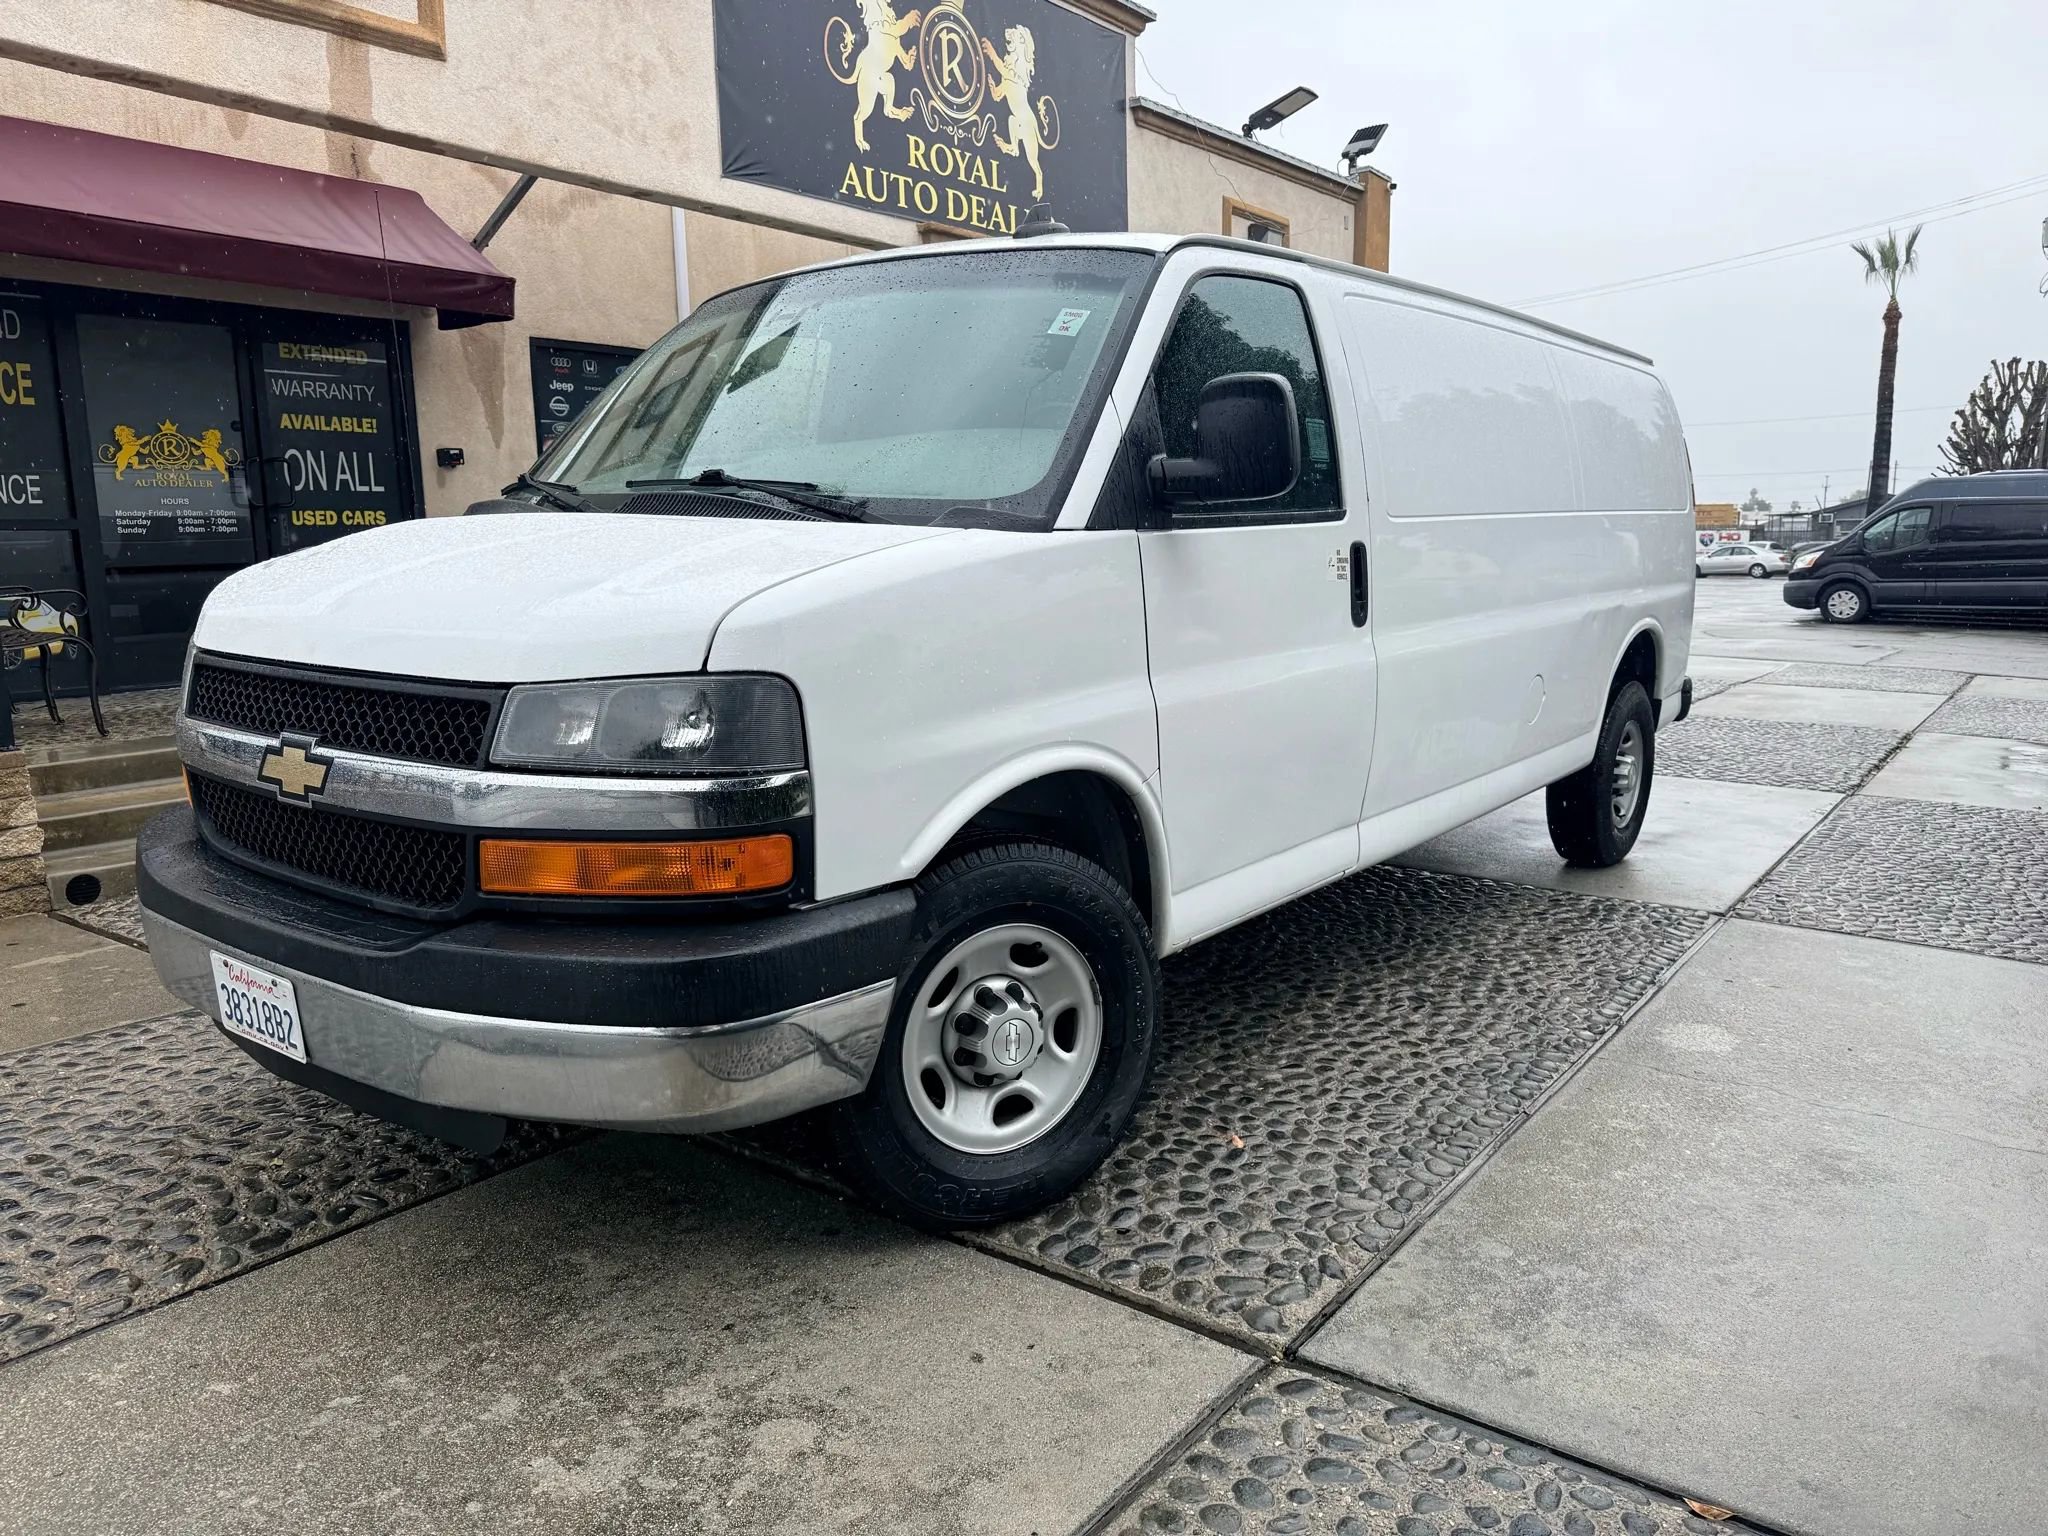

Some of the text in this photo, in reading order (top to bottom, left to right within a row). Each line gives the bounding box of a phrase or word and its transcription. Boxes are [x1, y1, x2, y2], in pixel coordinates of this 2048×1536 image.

[939, 28, 968, 93] R
[906, 134, 1007, 193] ROYAL
[839, 162, 1030, 235] AUTO DEAL
[279, 342, 368, 365] EXTENDED
[272, 378, 375, 402] WARRANTY
[549, 380, 574, 393] Jeep
[280, 413, 377, 434] AVAILABLE!
[162, 439, 180, 456] R
[155, 472, 193, 481] ROYAL
[283, 448, 385, 492] ON ALL
[134, 479, 214, 488] AUTO DEALER
[160, 497, 190, 505] HOURS
[115, 510, 173, 518] Monday-Friday
[209, 510, 236, 518] 7:00pm
[116, 518, 151, 526] Saturday
[291, 510, 387, 526] USED CARS
[117, 526, 147, 535] Sunday
[211, 526, 238, 534] 7:00pm
[228, 963, 280, 999] California
[220, 982, 298, 1050] 38318B2
